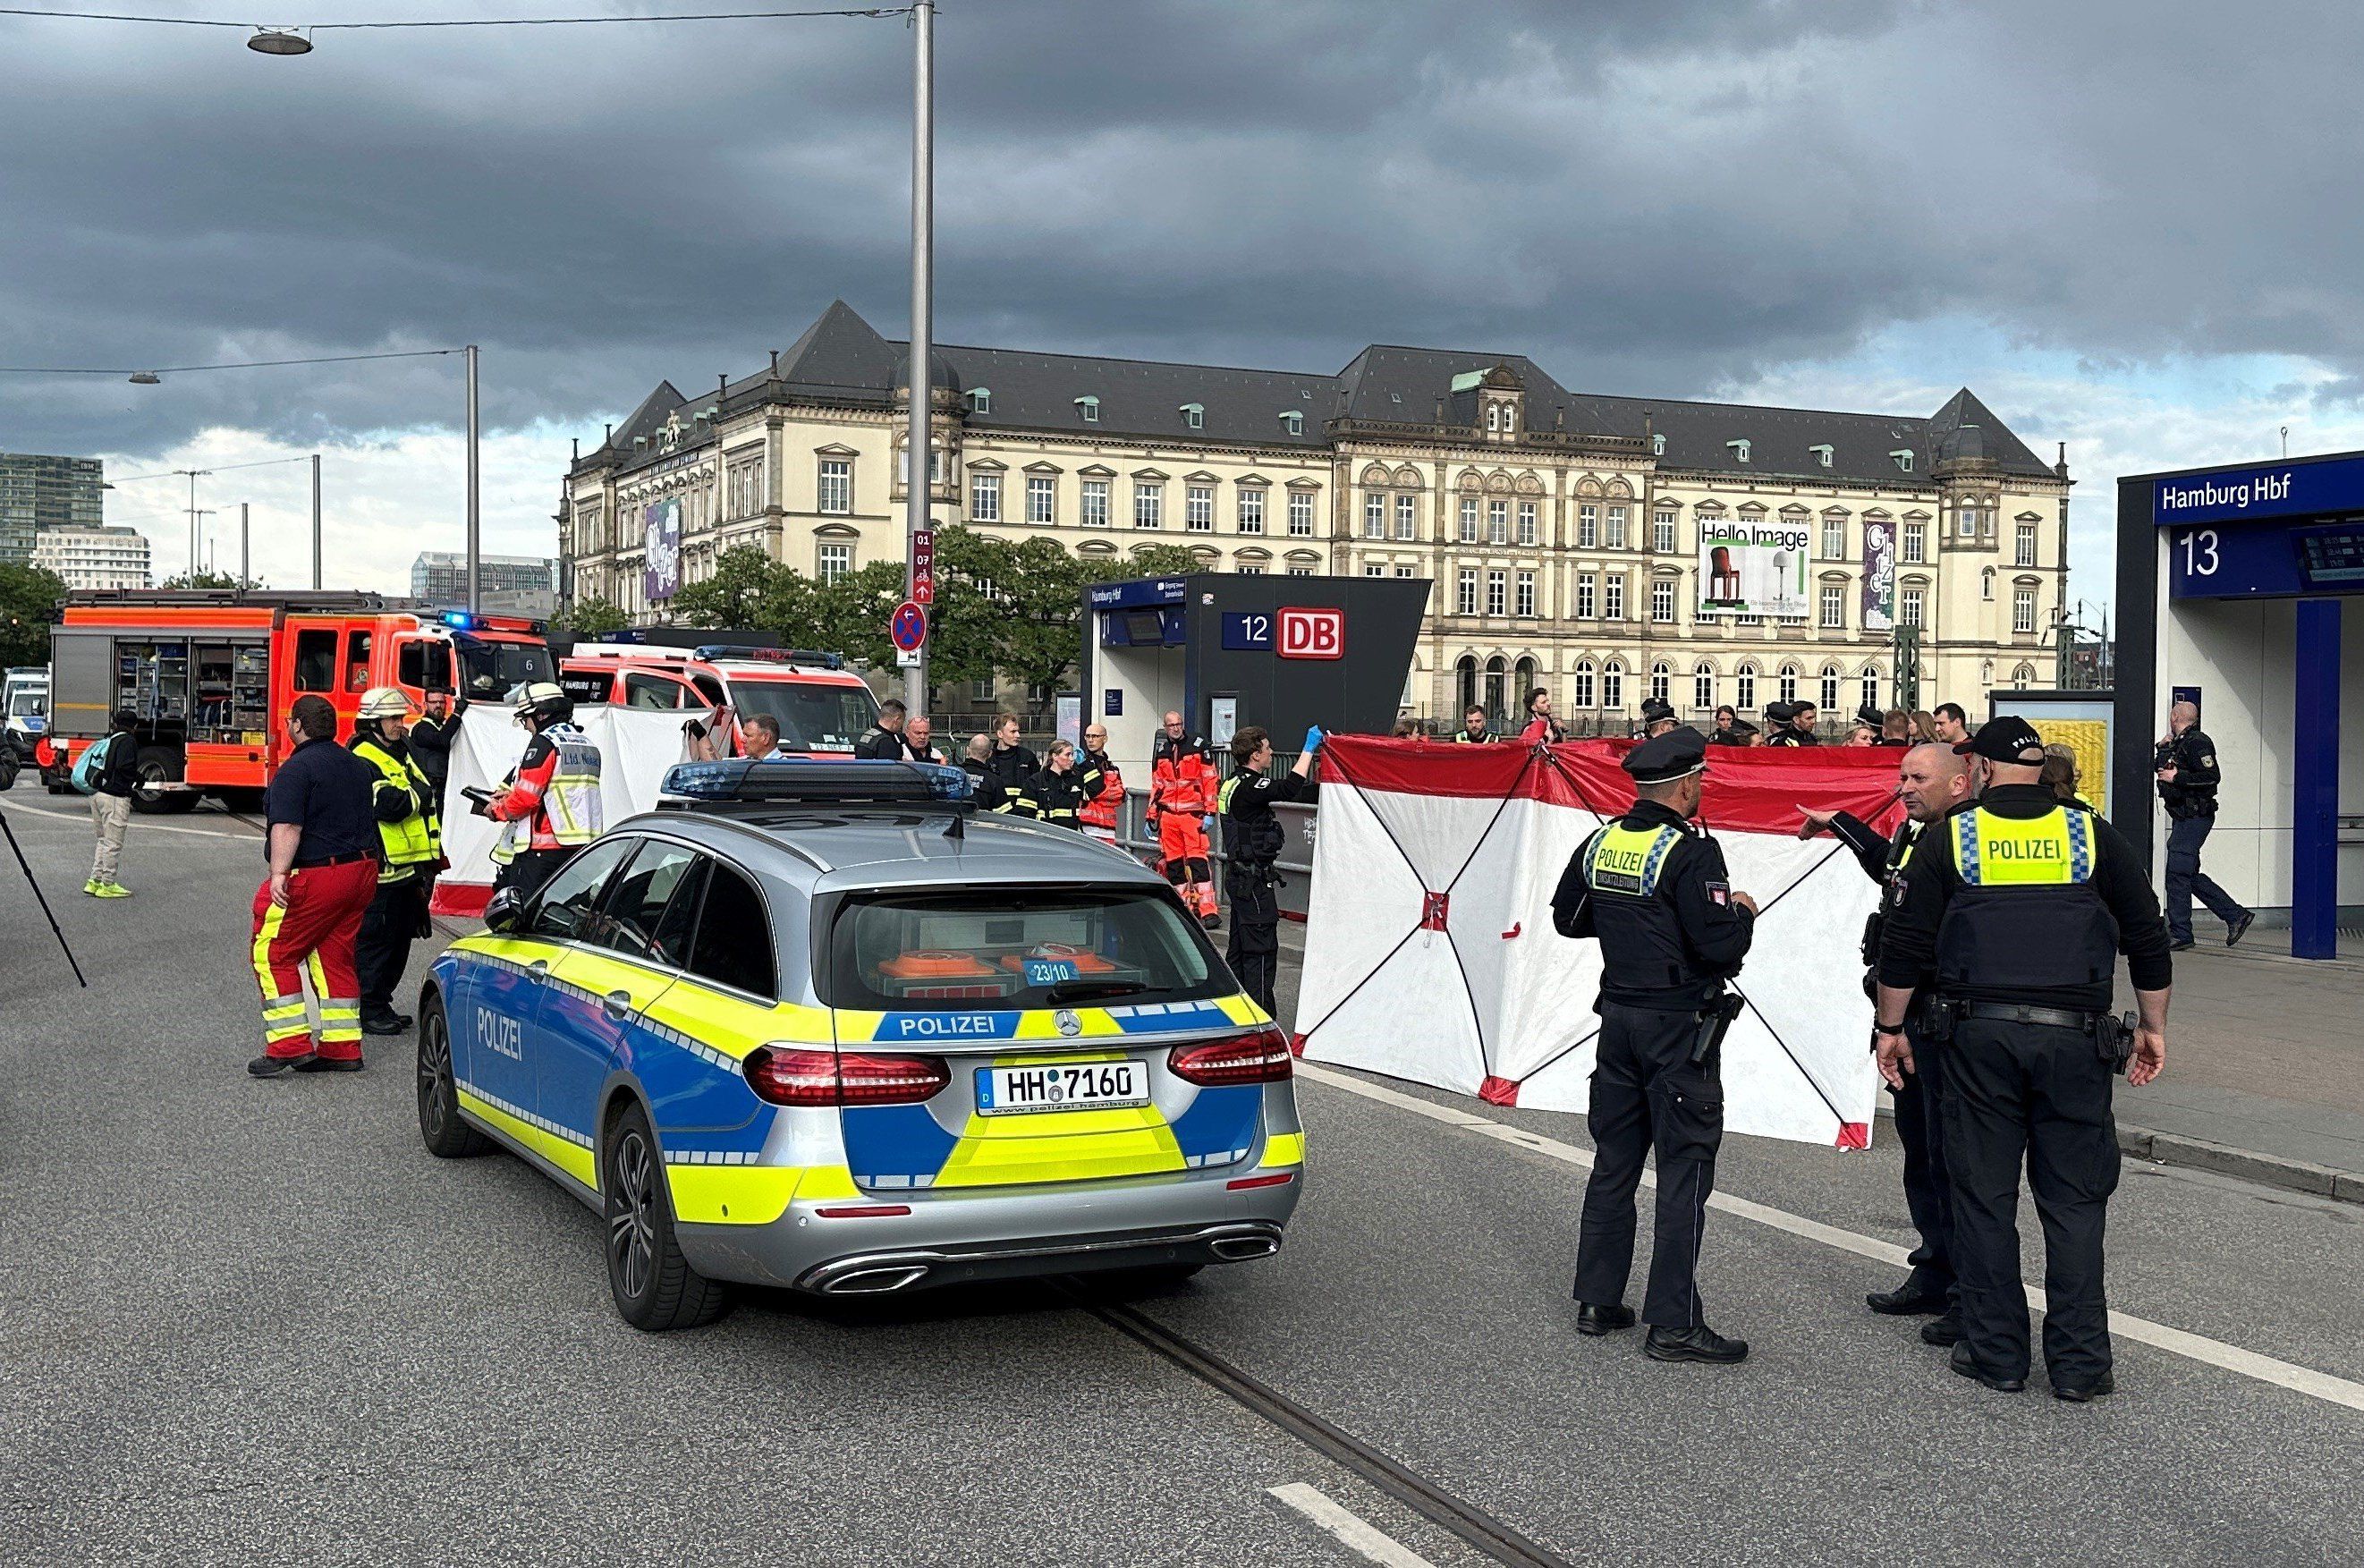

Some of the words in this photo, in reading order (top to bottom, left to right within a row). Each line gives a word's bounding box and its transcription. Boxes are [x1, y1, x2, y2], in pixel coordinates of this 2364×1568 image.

[2162, 481, 2249, 509] Hamburg
[2254, 472, 2292, 501] Hbf
[917, 535, 930, 546] 01
[1701, 523, 1748, 544] Hello
[1751, 525, 1809, 551] Image
[917, 555, 929, 565] 07
[2180, 530, 2220, 576] 13
[1241, 615, 1267, 640] 12
[1287, 616, 1336, 650] DB
[525, 659, 533, 671] 6
[2012, 734, 2042, 749] POLIZ
[1597, 848, 1644, 872] POLIZEI
[1988, 839, 2061, 860] POLIZEI
[1033, 964, 1069, 981] 23/10
[478, 1006, 521, 1062] POLIZEI
[900, 1016, 996, 1036] POLIZEI
[1008, 1072, 1046, 1102] HH
[1063, 1066, 1132, 1099] 7160
[982, 1093, 989, 1102] D
